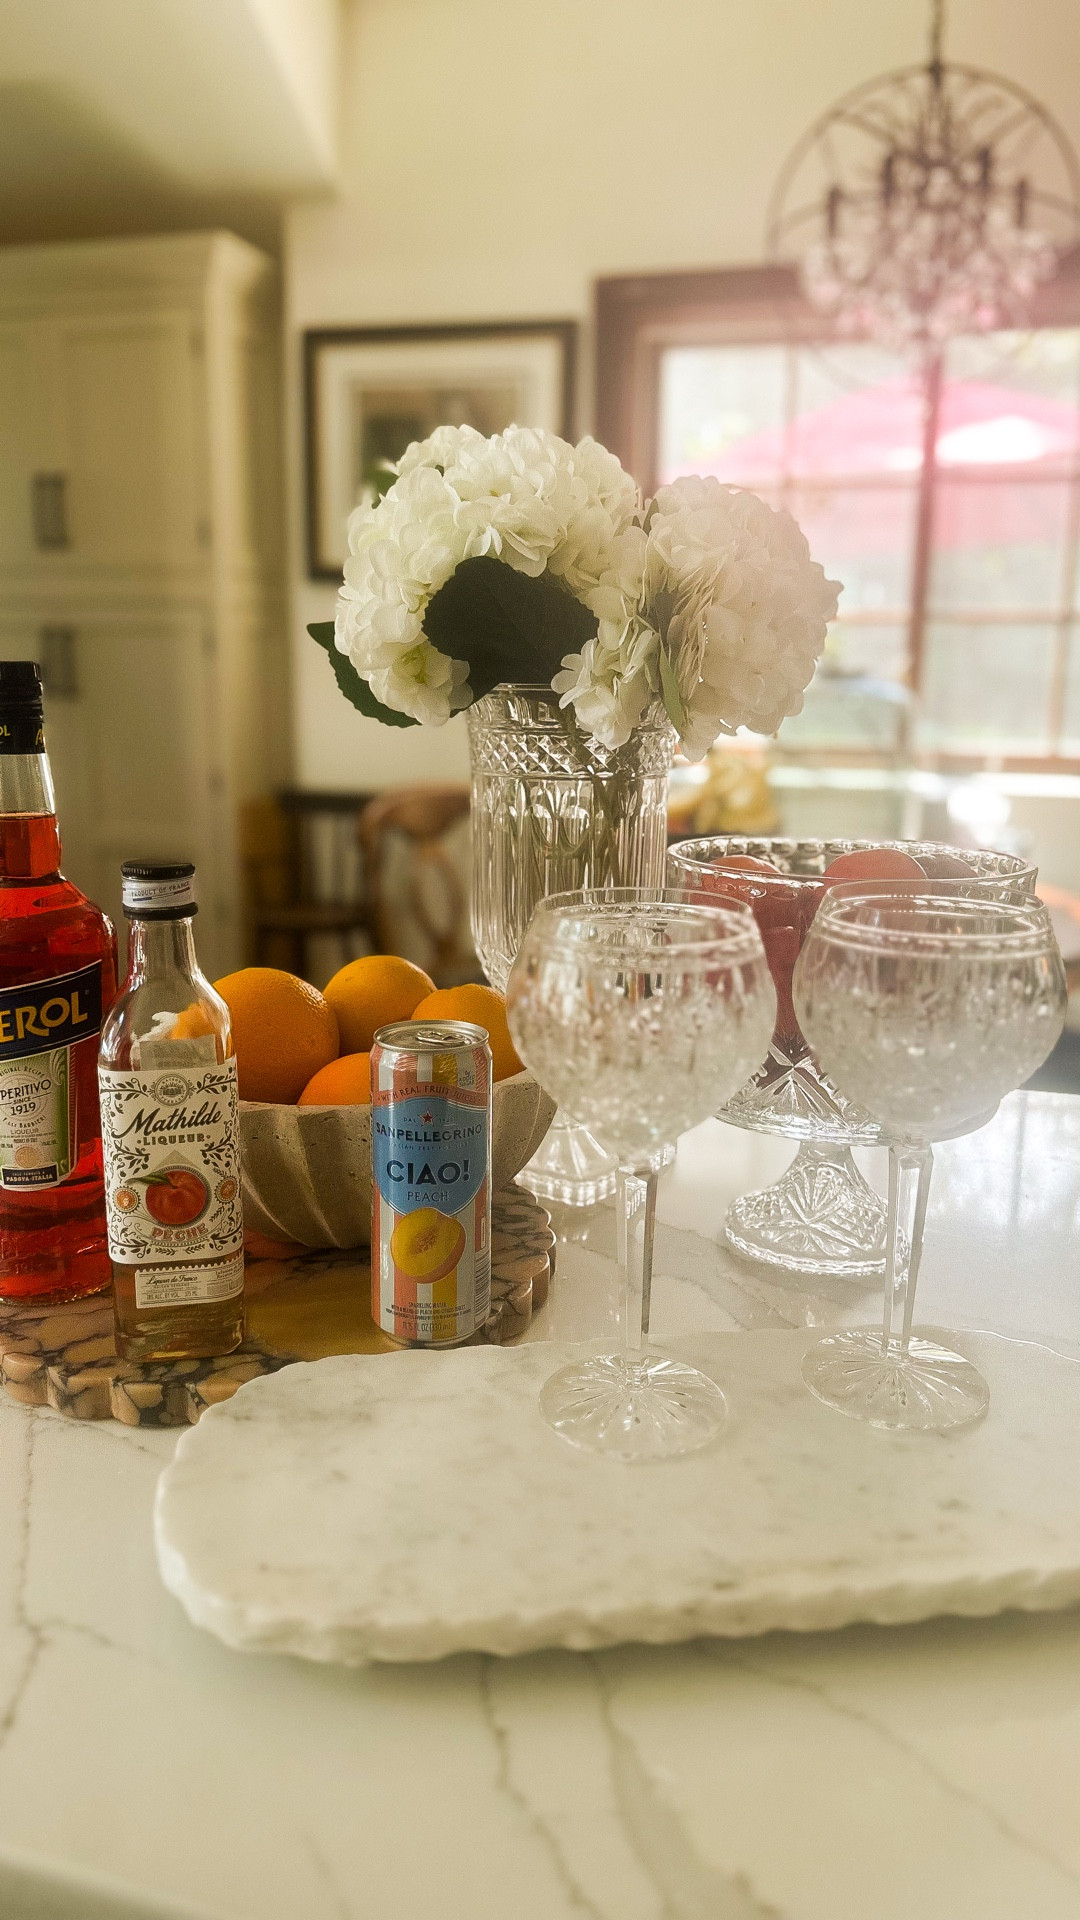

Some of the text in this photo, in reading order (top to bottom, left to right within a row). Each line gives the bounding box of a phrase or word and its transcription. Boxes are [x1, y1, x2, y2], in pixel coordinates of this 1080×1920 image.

[132, 889, 156, 897] PRODUCT
[169, 881, 190, 891] FRANCE
[13, 1096, 31, 1104] SINCE
[381, 1085, 477, 1103] WITH REAL FRUIT JUICES
[11, 1102, 36, 1116] 1919
[111, 1101, 222, 1139] Mathilde
[143, 1133, 205, 1146] LIQUEUR
[376, 1122, 483, 1142] SANPELLEGRINO
[386, 1160, 470, 1185] CIAO!
[408, 1191, 448, 1202] PEACH
[421, 1323, 428, 1332] OZ
